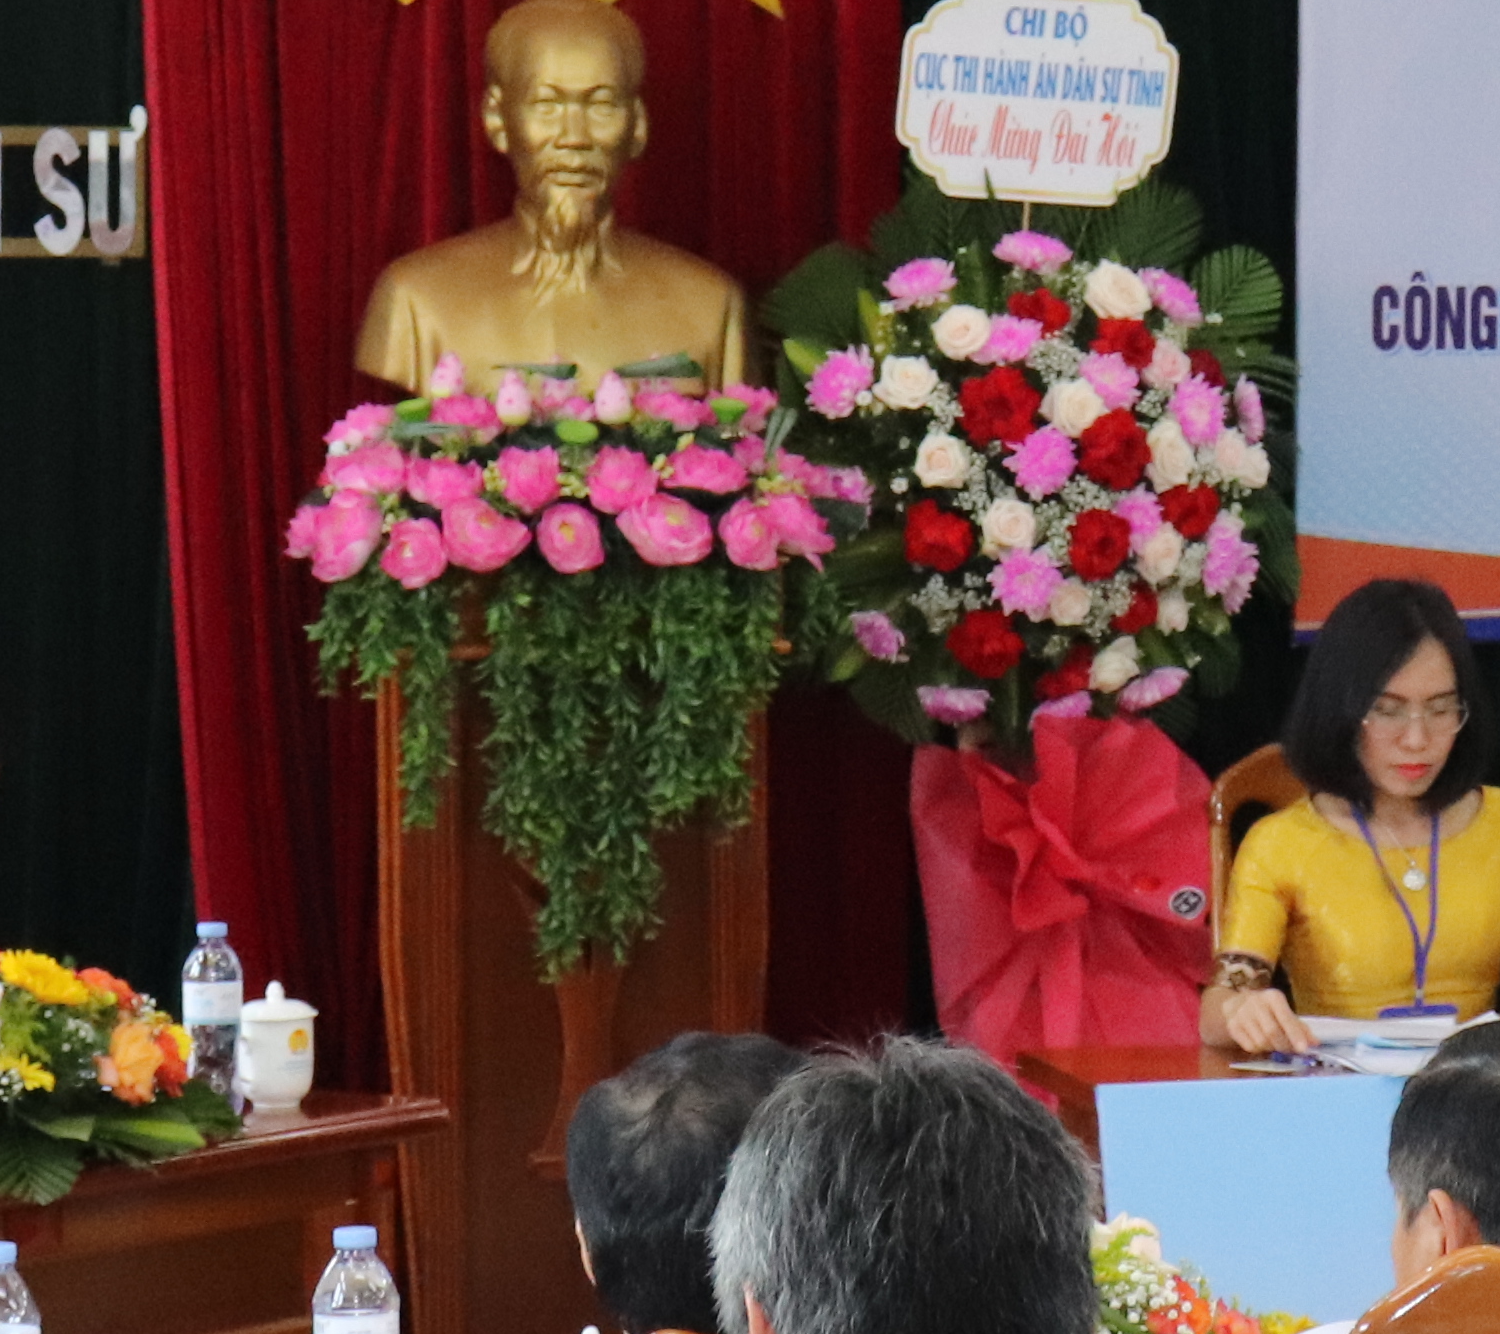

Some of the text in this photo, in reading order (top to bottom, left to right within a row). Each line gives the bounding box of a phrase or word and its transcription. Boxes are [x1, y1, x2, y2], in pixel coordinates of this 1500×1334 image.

[1006, 5, 1089, 47] CHI BỘ
[914, 48, 1167, 111] CỤC THI HÀNH ÁN DÂN SỰ TỈNH
[1372, 271, 1498, 351] CÔNG
